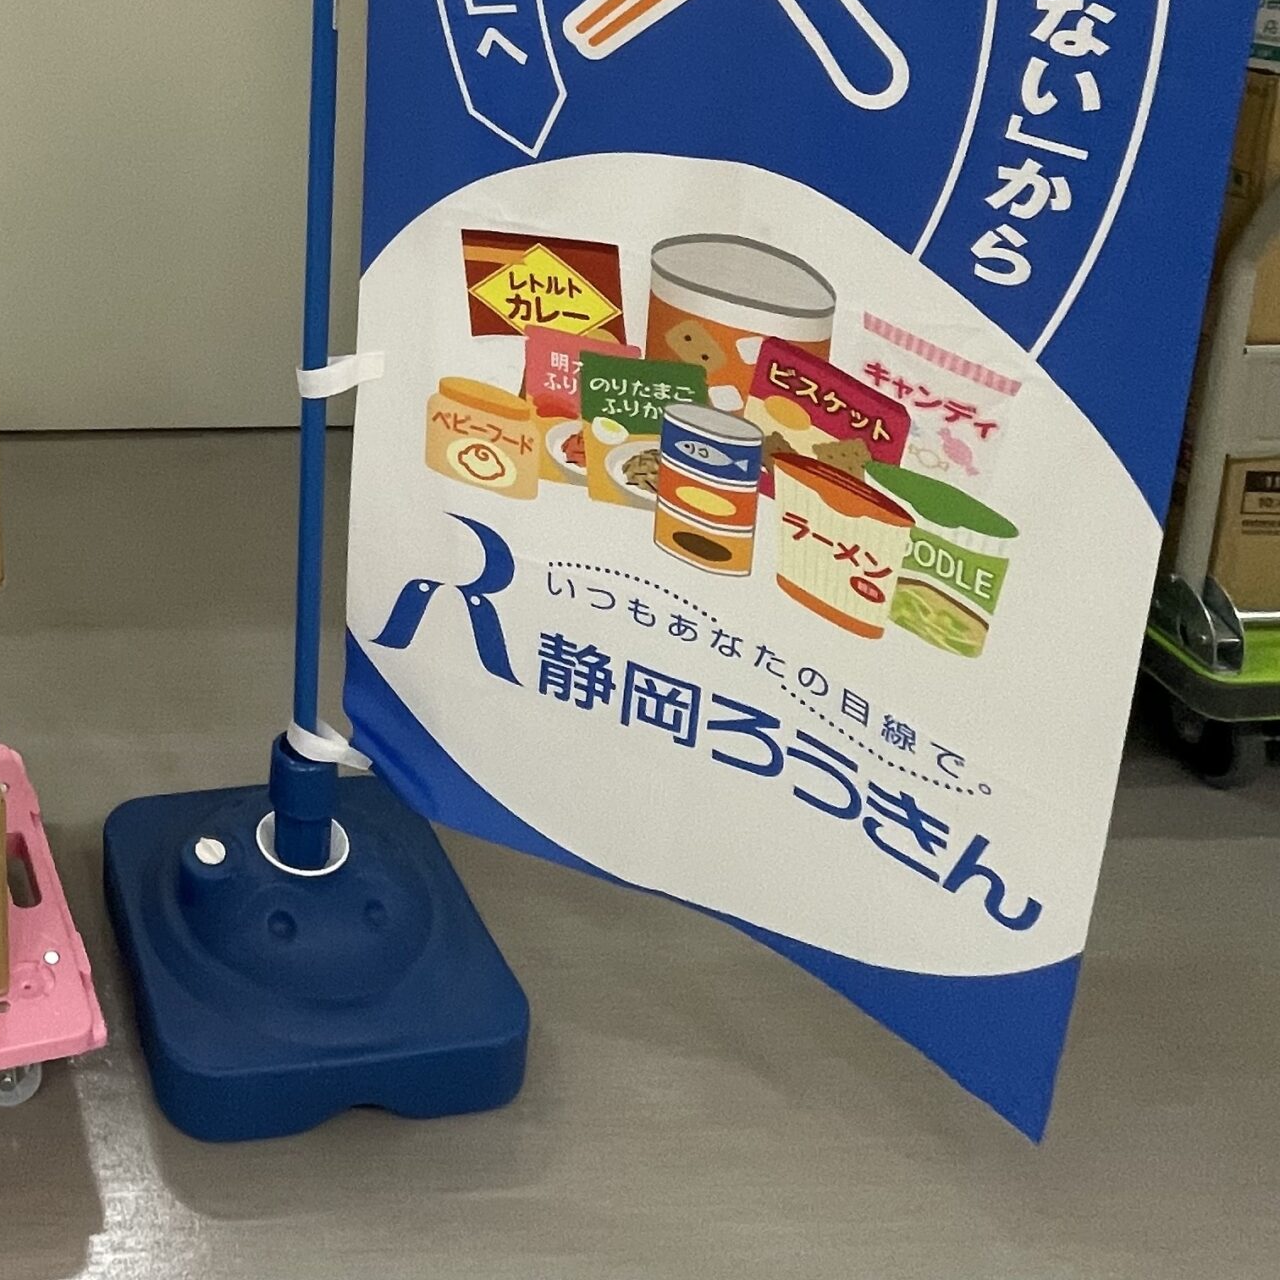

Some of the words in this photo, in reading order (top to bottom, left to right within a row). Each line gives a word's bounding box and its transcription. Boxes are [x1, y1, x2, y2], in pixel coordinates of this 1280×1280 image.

[505, 295, 591, 324] カレー
[507, 271, 584, 300] レトルト
[589, 377, 696, 402] のりたまご
[767, 359, 892, 444] ビスケット
[862, 360, 1001, 439] キャンディ
[431, 407, 535, 457] ベビーフード
[782, 511, 893, 579] ラーメン
[546, 570, 994, 798] いつもあなたの目線で。
[537, 633, 1043, 932] 静岡ろうきん
